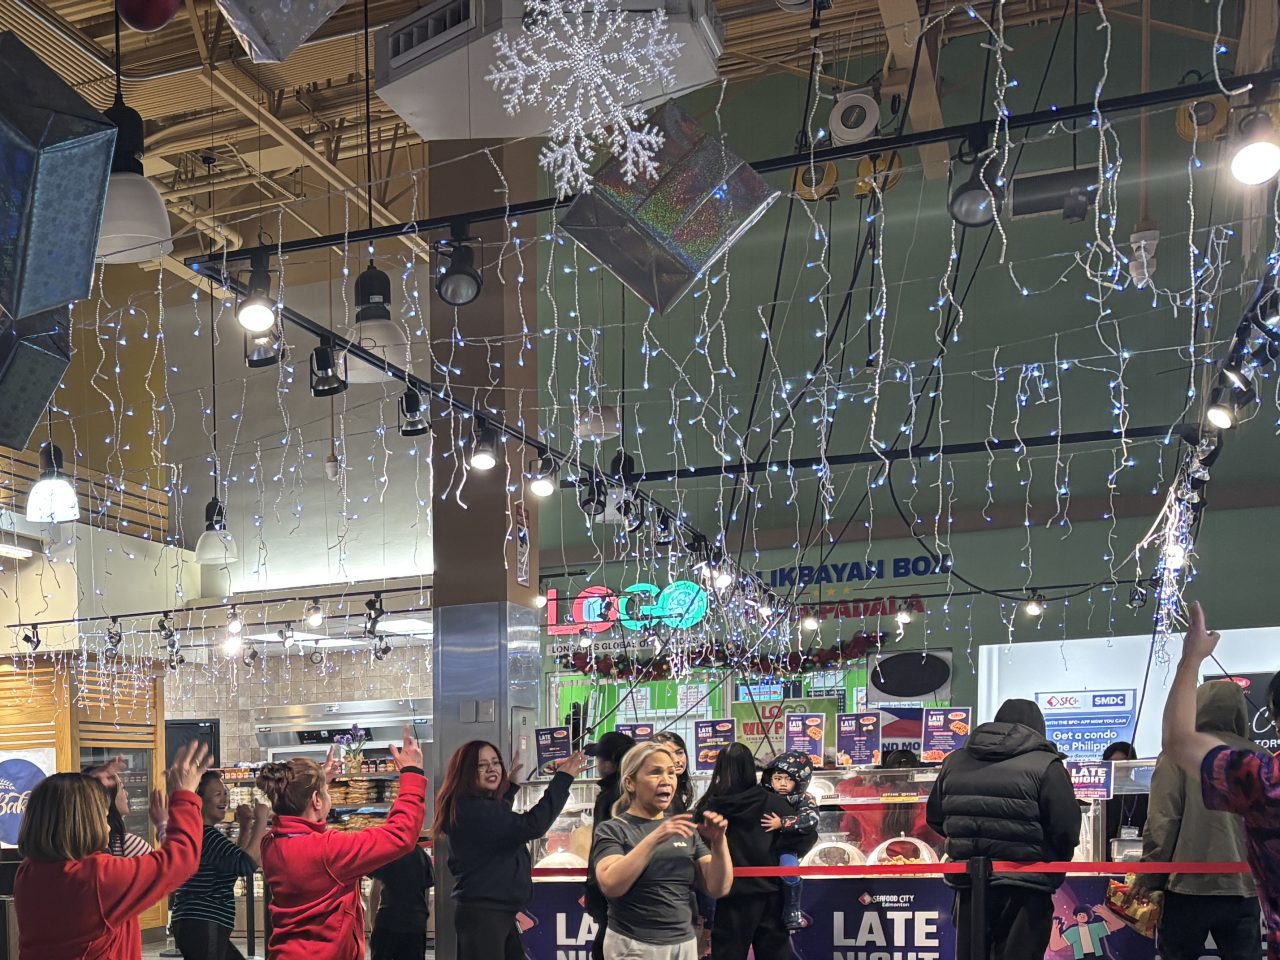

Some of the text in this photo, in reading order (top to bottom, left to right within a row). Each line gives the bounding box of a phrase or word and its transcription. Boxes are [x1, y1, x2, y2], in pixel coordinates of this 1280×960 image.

[756, 554, 950, 589] LIKBAYAN BOX
[547, 580, 708, 636] LOGO
[1094, 696, 1124, 705] SMDC
[1052, 729, 1117, 740] Get a condo
[901, 742, 921, 751] MO
[1072, 740, 1111, 752] Philippi
[1071, 767, 1107, 777] LATE
[1071, 776, 1106, 784] NIGHT
[872, 894, 915, 903] SEAFOOD CITY
[833, 911, 940, 947] LATE
